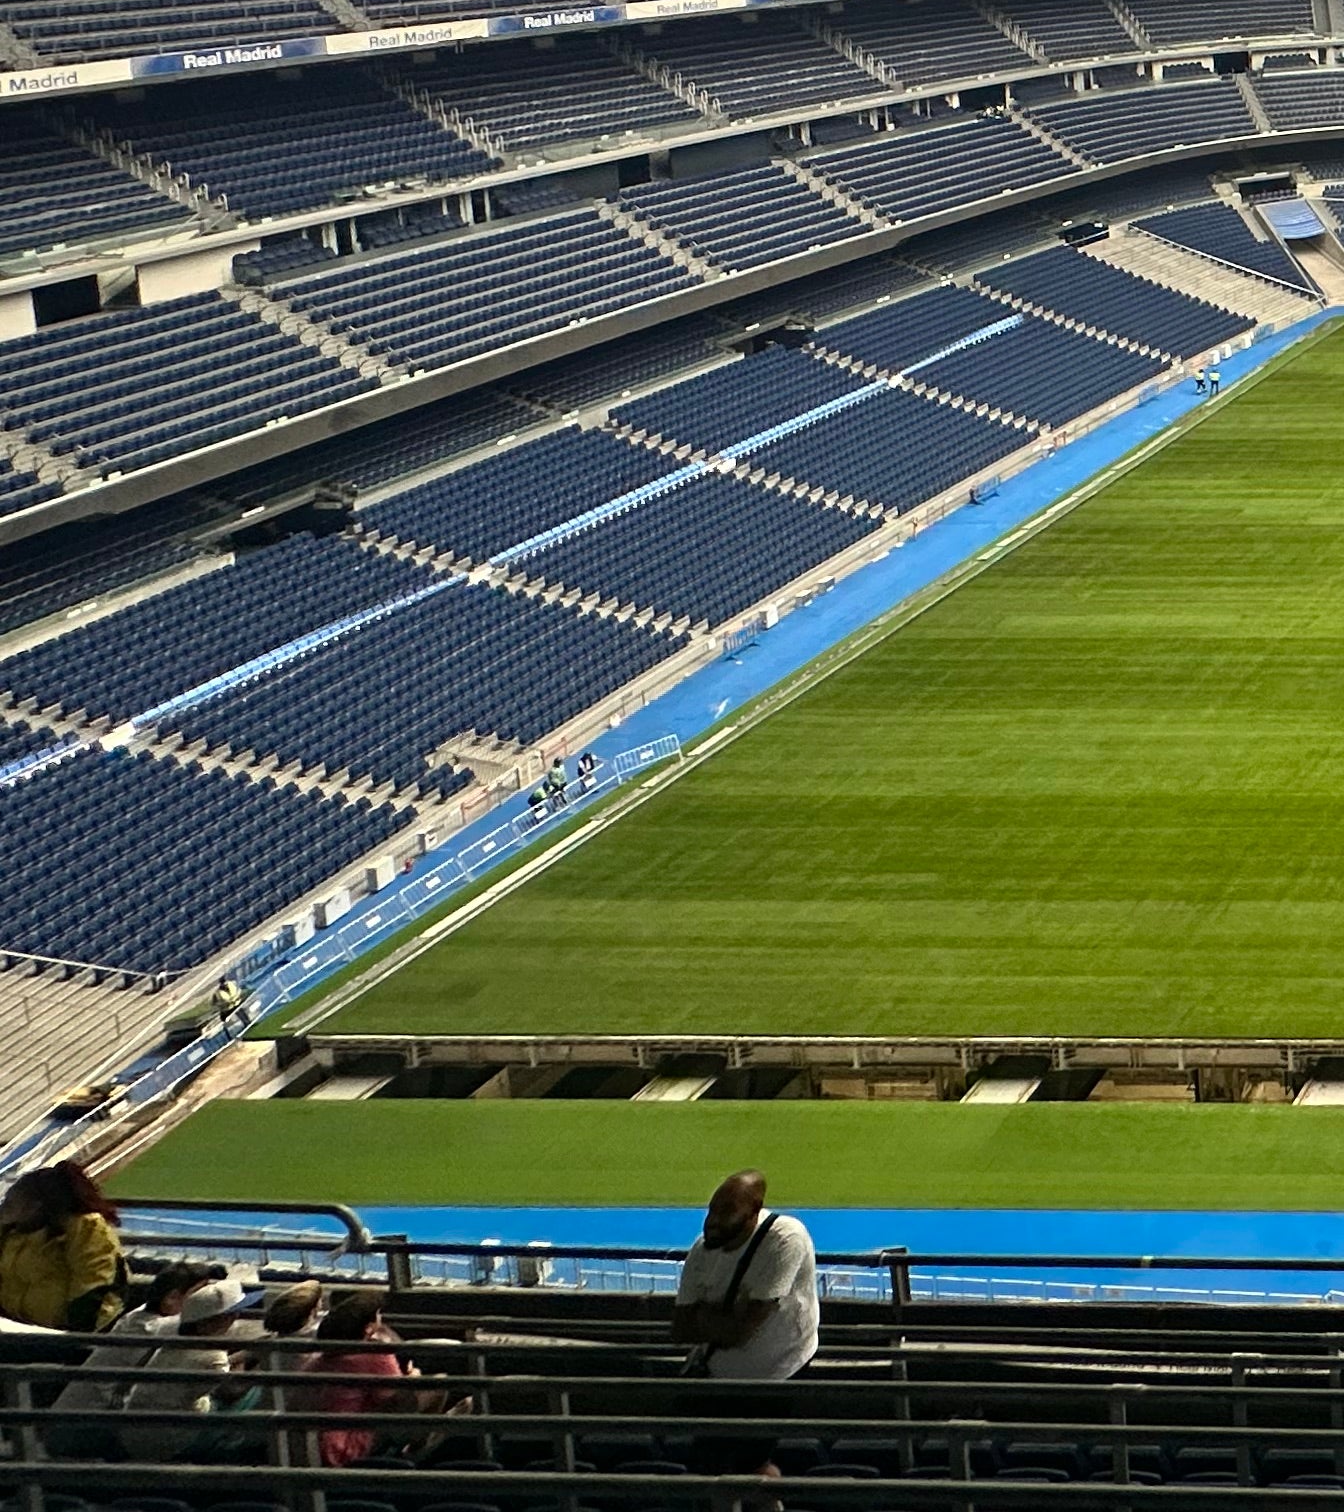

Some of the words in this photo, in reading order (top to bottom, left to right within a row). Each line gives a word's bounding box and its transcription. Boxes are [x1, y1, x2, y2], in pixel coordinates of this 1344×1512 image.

[657, 1, 681, 14] Real
[683, 0, 718, 12] Madrid
[524, 16, 551, 29] Real
[554, 10, 595, 26] Madrid
[369, 35, 400, 49] Real
[404, 28, 452, 44] Madrid
[183, 52, 222, 69] Real
[226, 44, 282, 66] Madrid
[9, 71, 78, 92] Madrid
